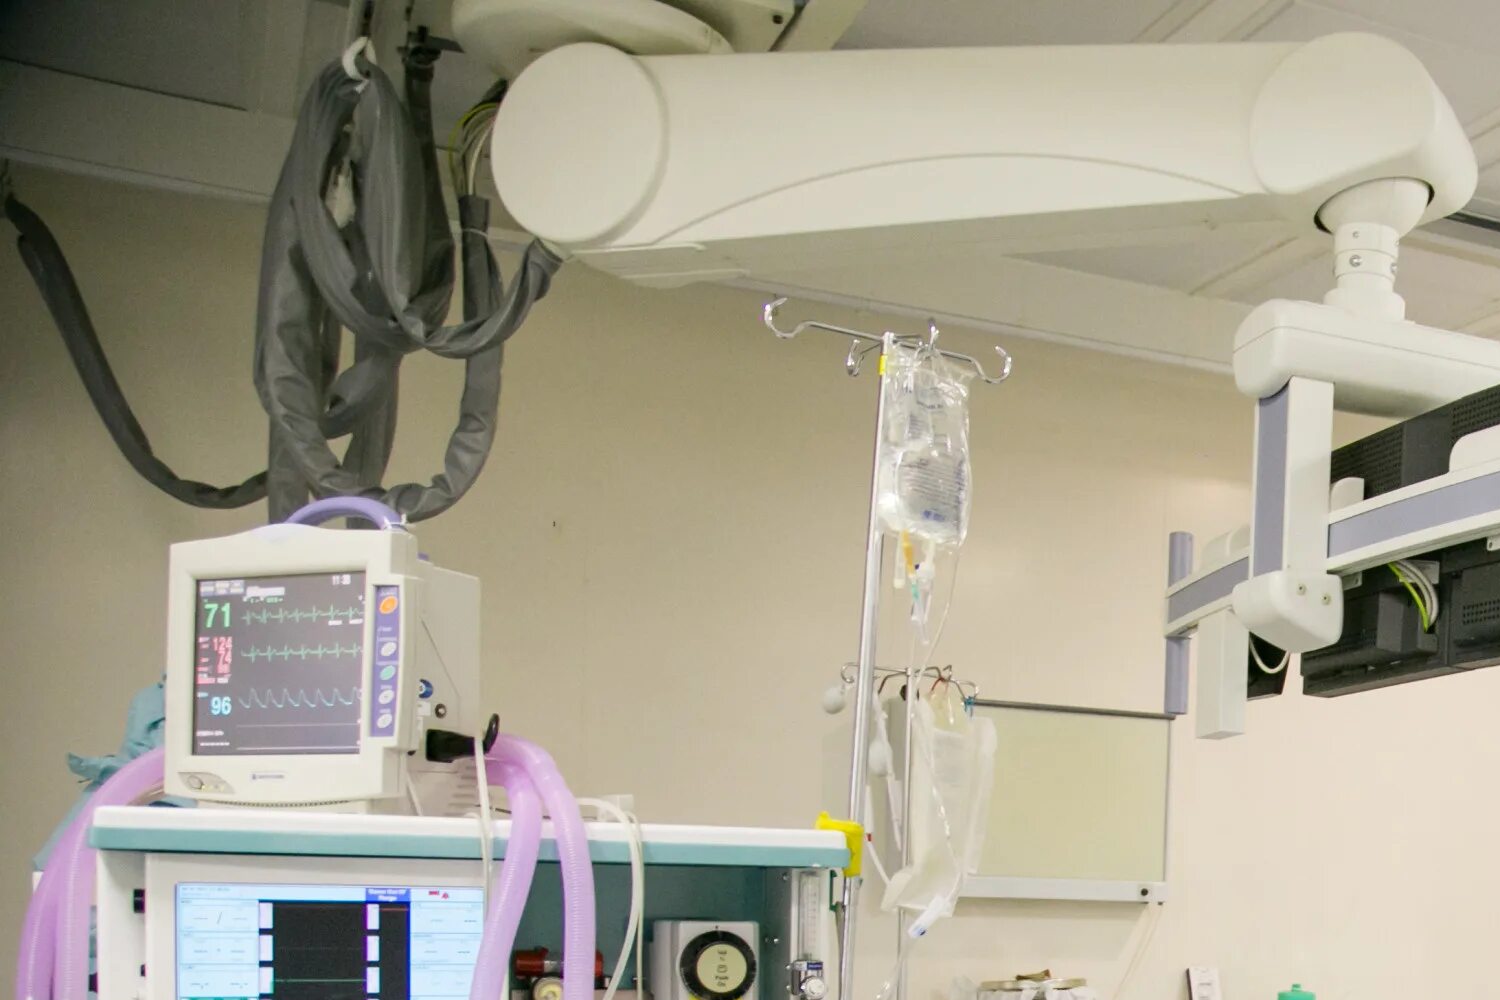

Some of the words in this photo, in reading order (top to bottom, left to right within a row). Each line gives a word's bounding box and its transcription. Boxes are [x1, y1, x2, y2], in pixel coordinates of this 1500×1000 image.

[204, 602, 231, 628] 71
[212, 636, 232, 650] 124
[211, 696, 232, 715] 96
